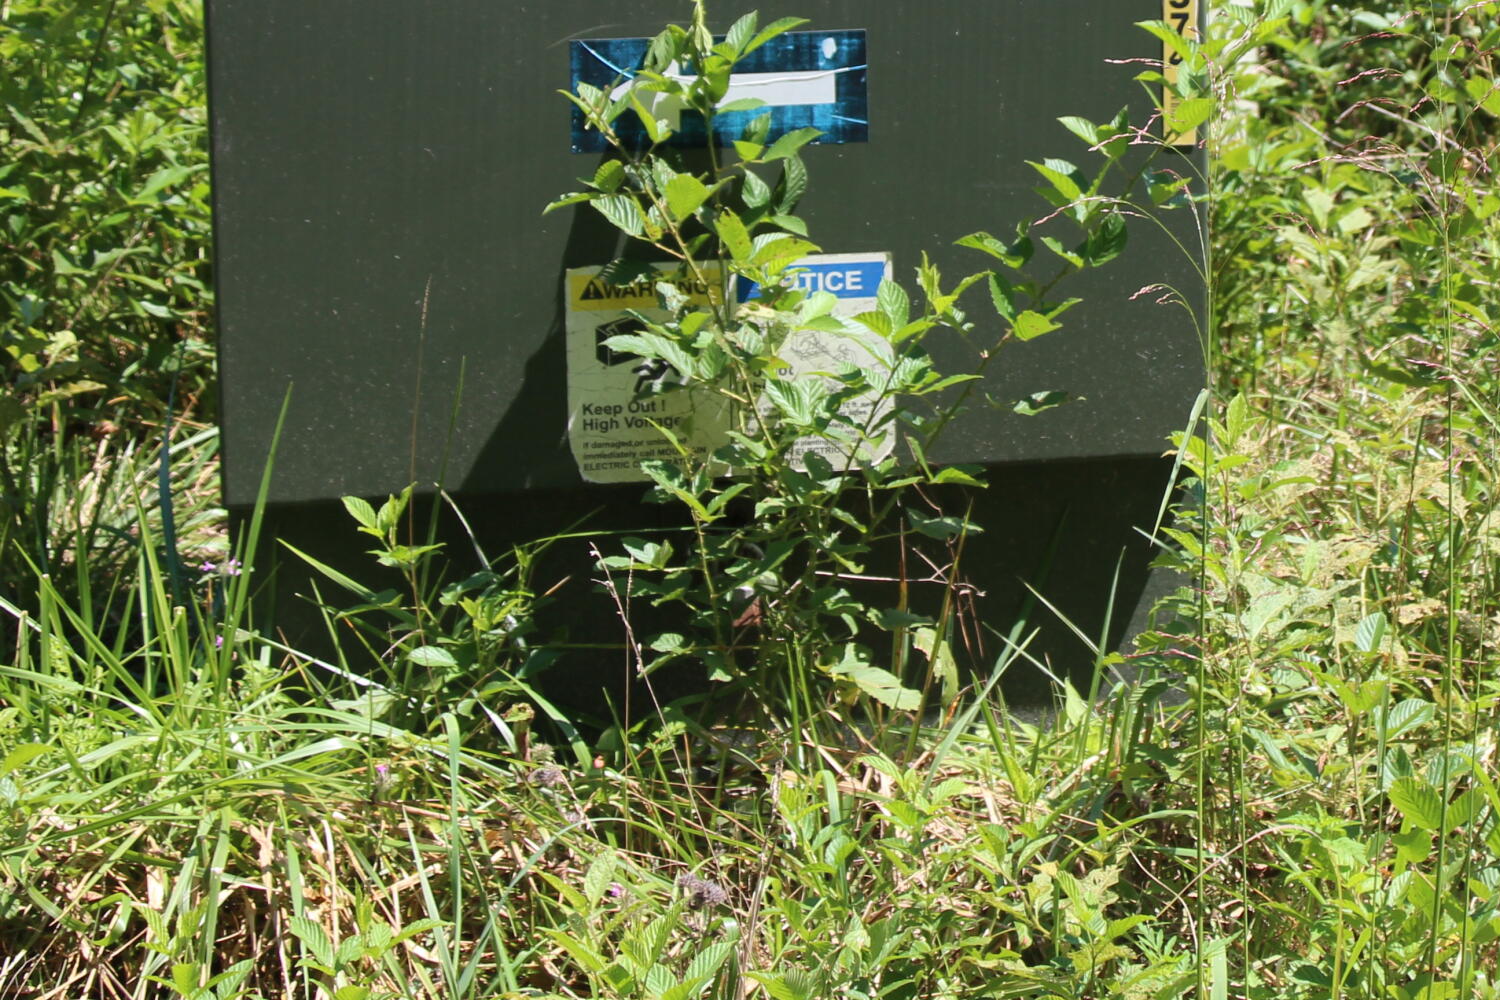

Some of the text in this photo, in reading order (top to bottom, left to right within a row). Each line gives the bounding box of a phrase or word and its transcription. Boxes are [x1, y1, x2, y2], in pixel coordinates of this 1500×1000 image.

[780, 270, 863, 292] TICE
[582, 402, 623, 416] Keep
[627, 400, 657, 414] Out
[583, 417, 620, 433] High
[584, 461, 630, 472] ELECTRIC
